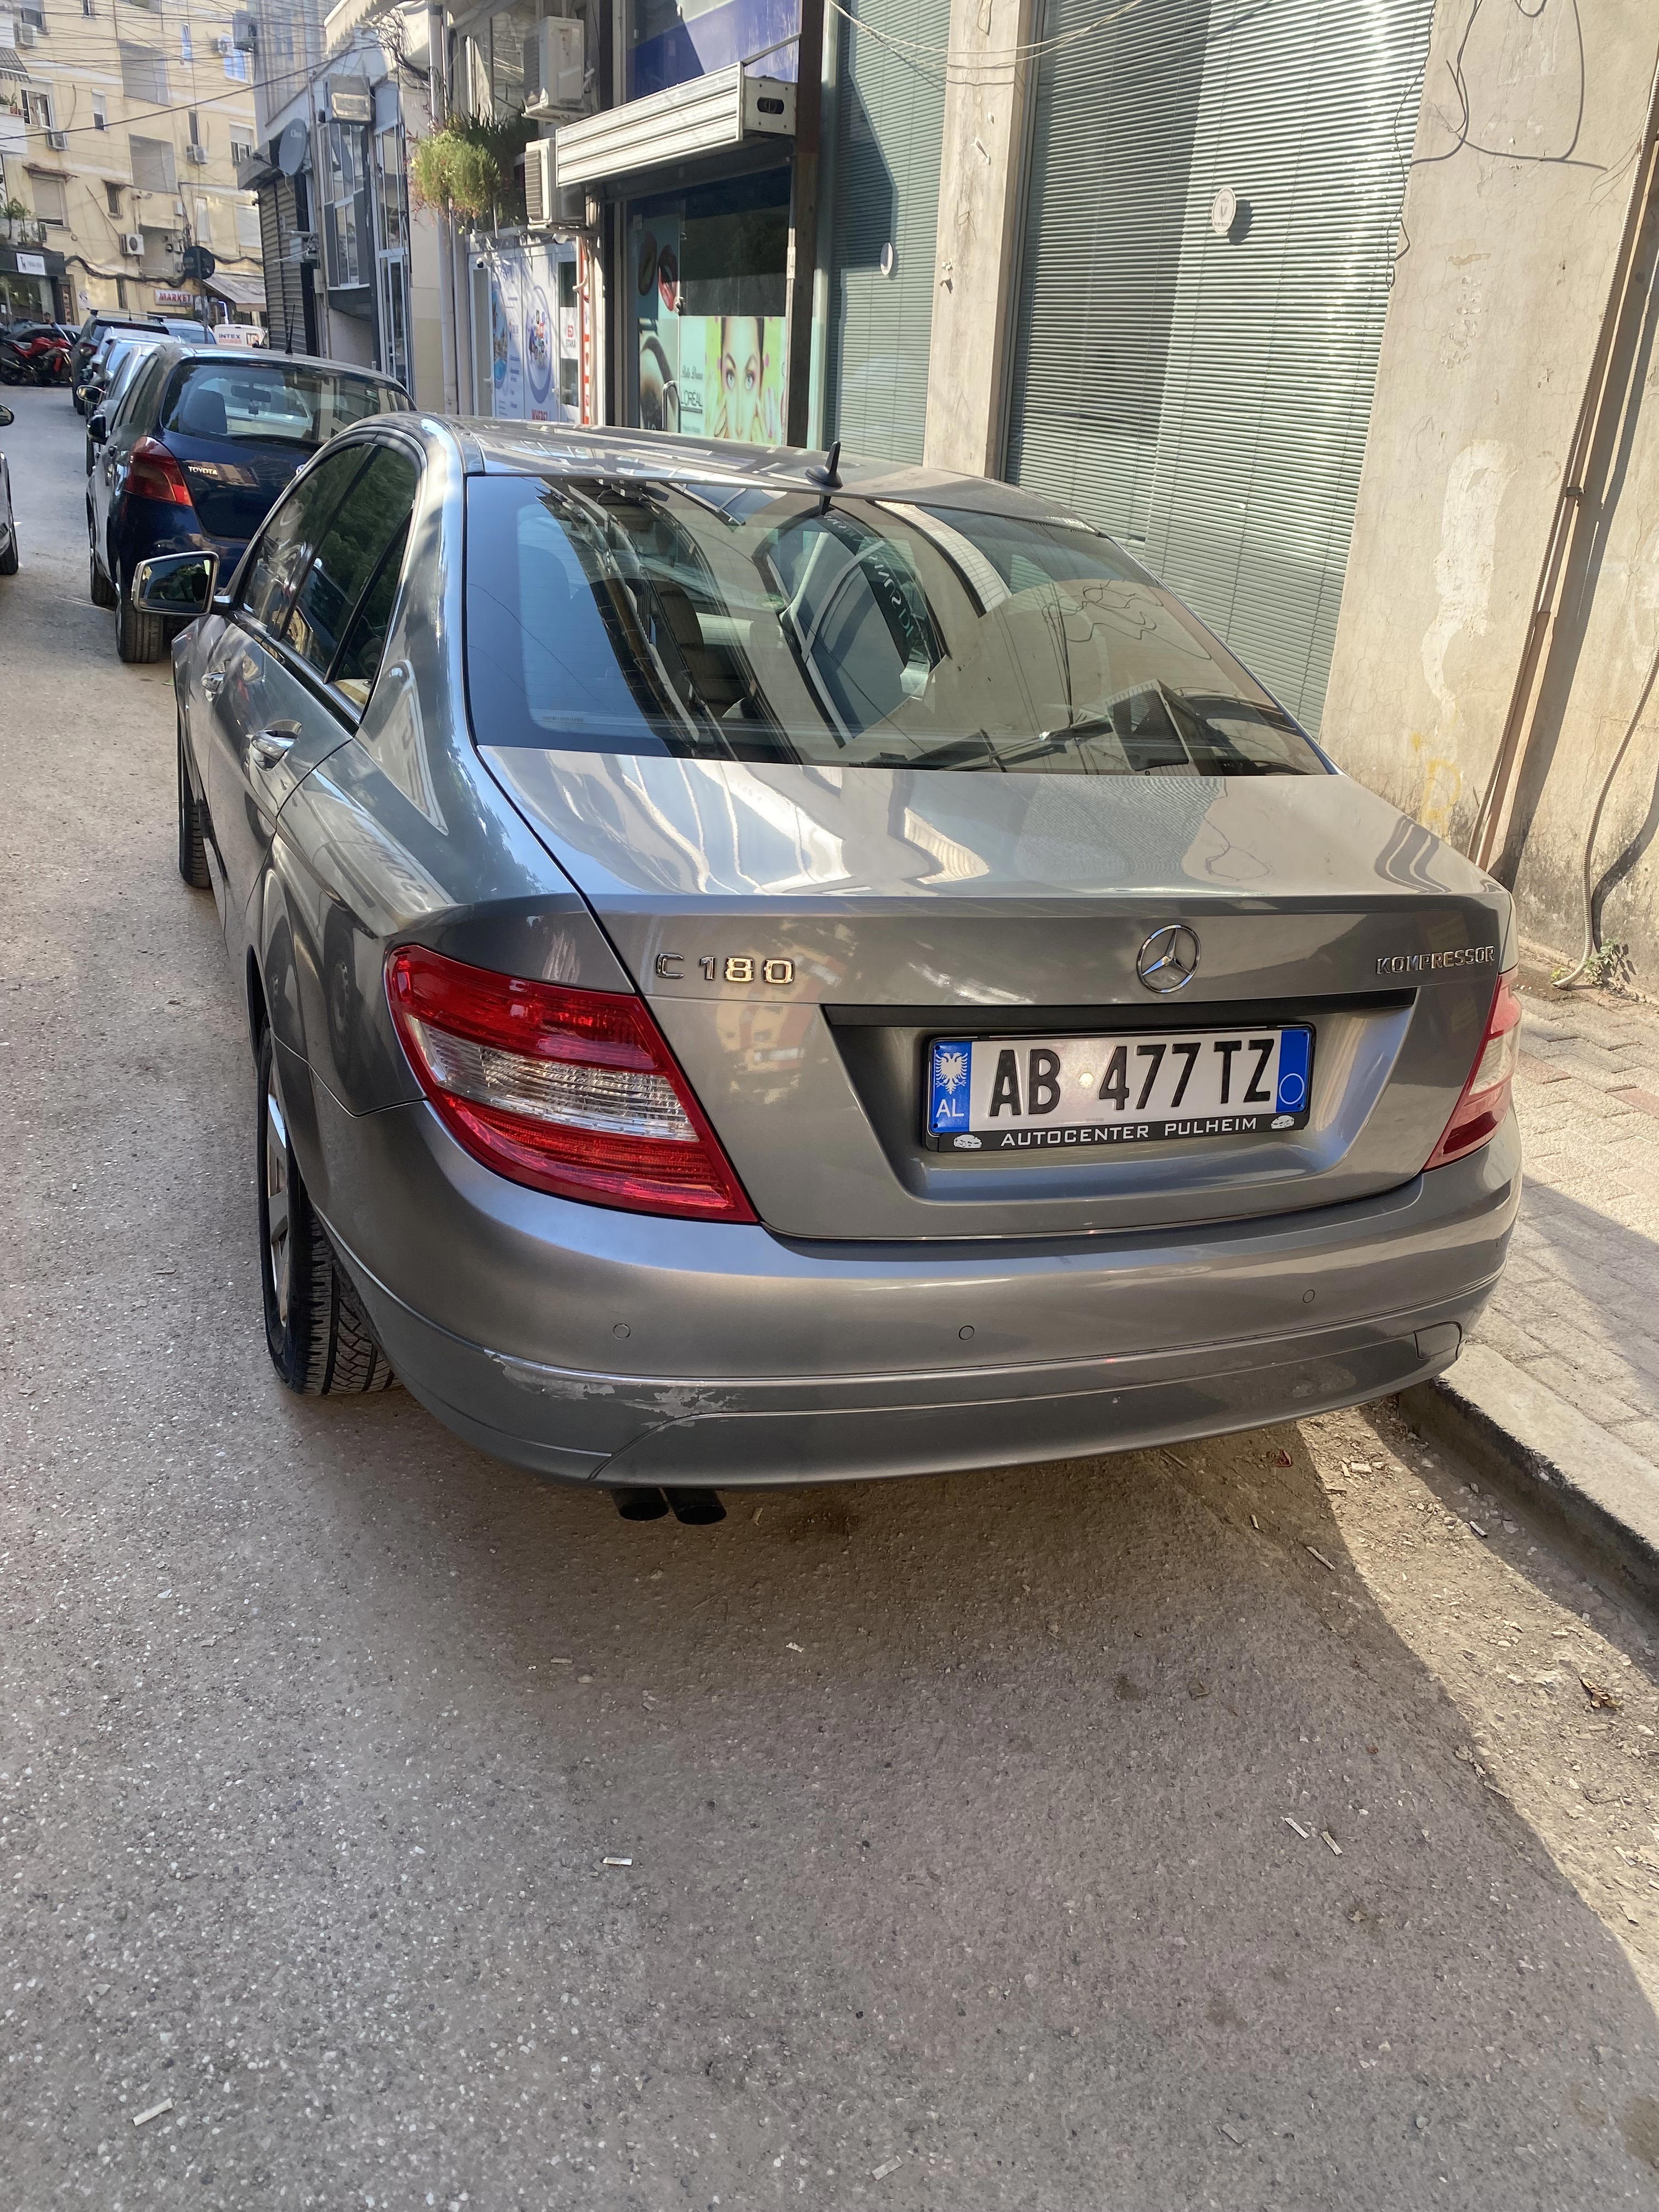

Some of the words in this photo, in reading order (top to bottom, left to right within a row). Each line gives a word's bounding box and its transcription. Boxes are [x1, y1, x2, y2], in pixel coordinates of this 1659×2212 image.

[159, 292, 191, 302] MARKET
[188, 466, 218, 475] TOYOTA
[656, 953, 685, 979] C
[699, 956, 795, 984] 180
[1375, 945, 1496, 975] KOMPRESSOR
[989, 1048, 1061, 1117] AB
[1098, 1042, 1201, 1110] 477
[1213, 1039, 1275, 1104] TZ
[935, 1098, 964, 1118] AL
[1000, 1125, 1149, 1147] AUTOCENTER
[1164, 1117, 1257, 1137] PULHEIM
